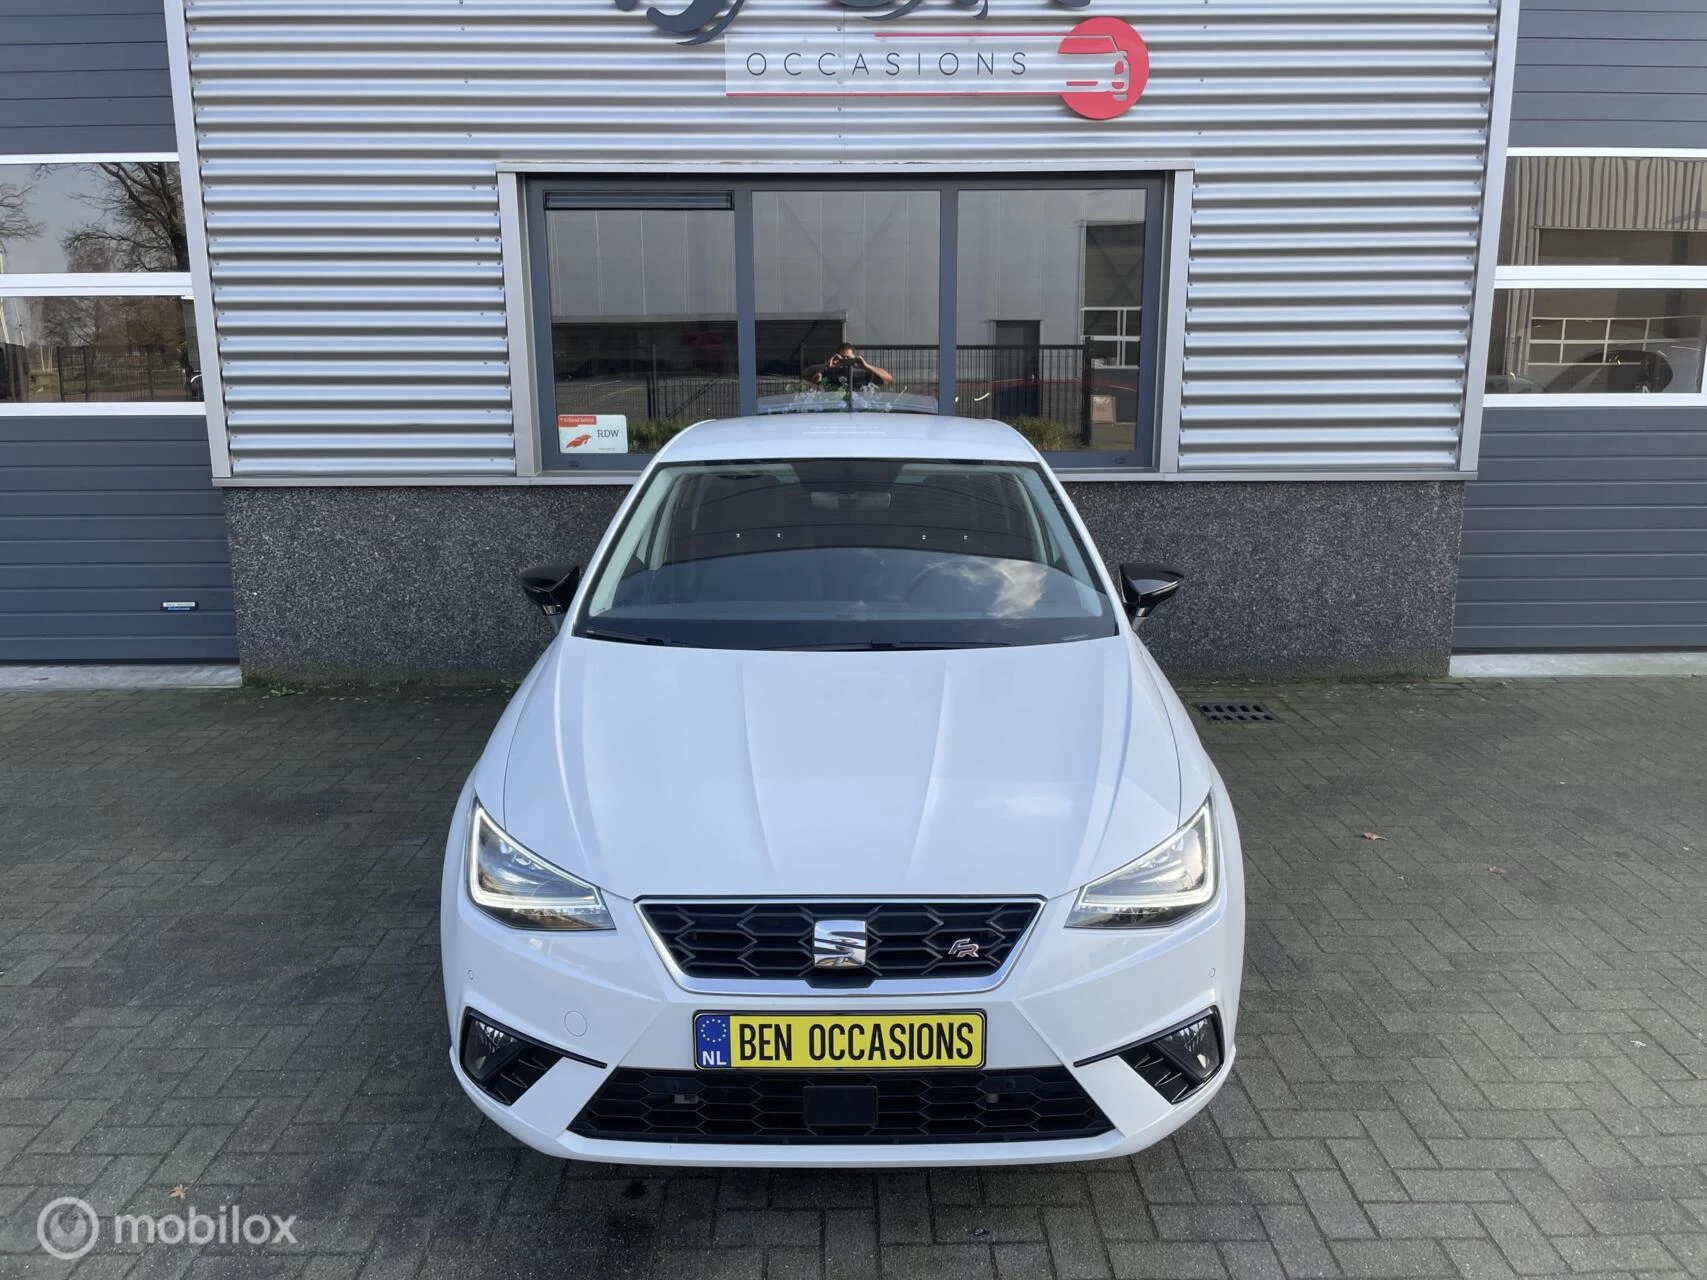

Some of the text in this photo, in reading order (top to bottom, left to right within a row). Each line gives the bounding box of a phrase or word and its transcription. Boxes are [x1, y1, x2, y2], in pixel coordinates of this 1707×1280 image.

[746, 52, 1027, 76] OCCASIONS
[597, 429, 619, 438] RDW
[739, 1022, 974, 1061] BEN OCCASIONS
[702, 1051, 727, 1066] NL
